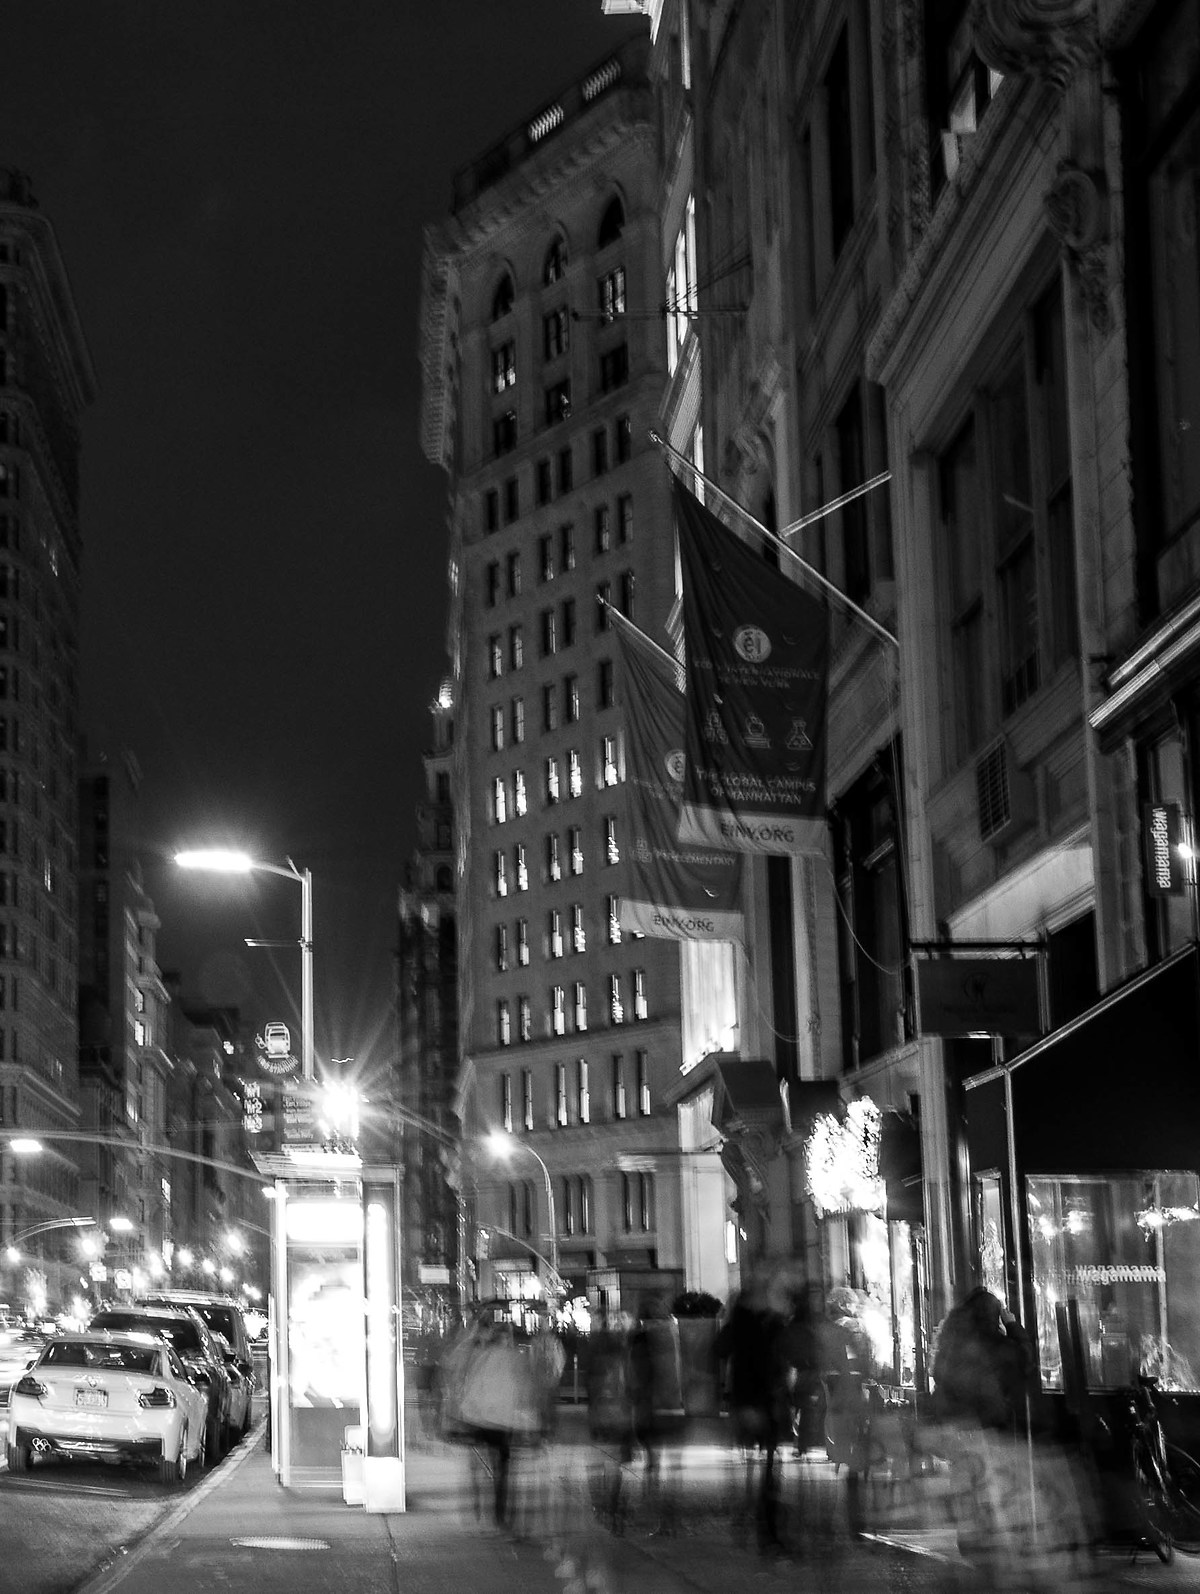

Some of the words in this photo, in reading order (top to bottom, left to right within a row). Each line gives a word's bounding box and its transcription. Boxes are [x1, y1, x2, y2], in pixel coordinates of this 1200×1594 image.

[1150, 807, 1171, 888] wagamama
[244, 1097, 263, 1114] M2
[1075, 1264, 1167, 1286] wagamama
